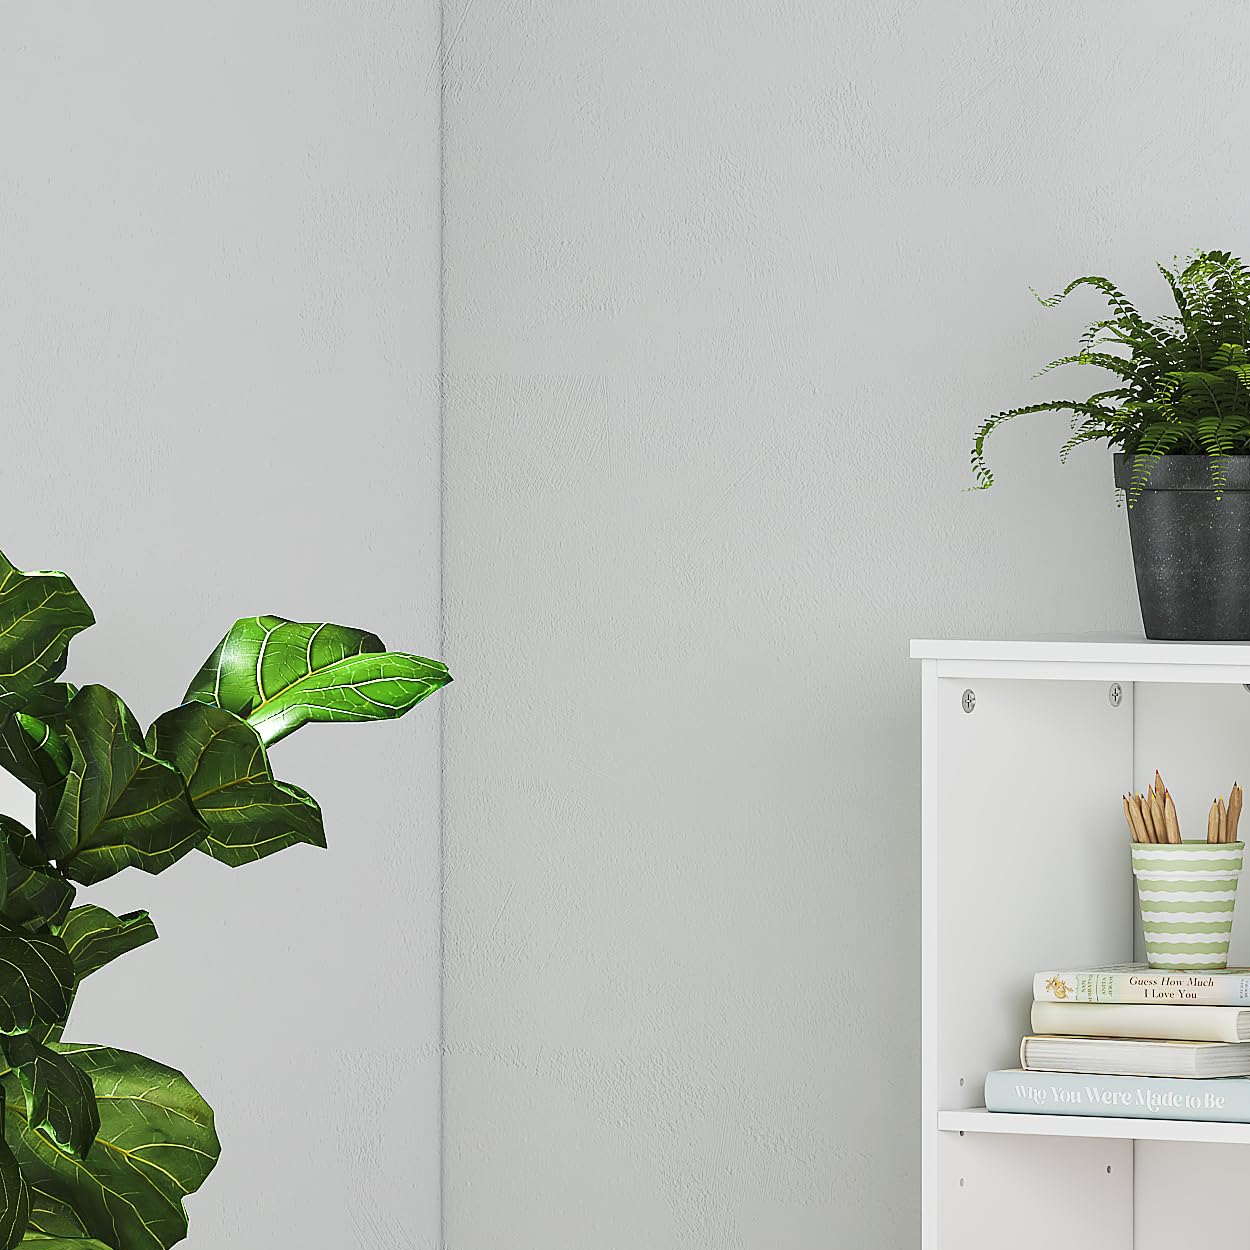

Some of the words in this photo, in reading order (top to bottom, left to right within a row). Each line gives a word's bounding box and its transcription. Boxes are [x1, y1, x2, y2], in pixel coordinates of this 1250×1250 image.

[1129, 976, 1158, 986] Guess
[1161, 976, 1184, 986] How
[1187, 977, 1214, 987] Much
[1143, 988, 1148, 998] I
[1152, 989, 1175, 999] Love
[1178, 989, 1197, 999] You
[1015, 1085, 1047, 1105] Who
[1050, 1086, 1081, 1104] You
[1084, 1086, 1132, 1106] Were
[1135, 1088, 1183, 1113] Made
[1185, 1095, 1201, 1109] to
[1204, 1093, 1225, 1109] Be
